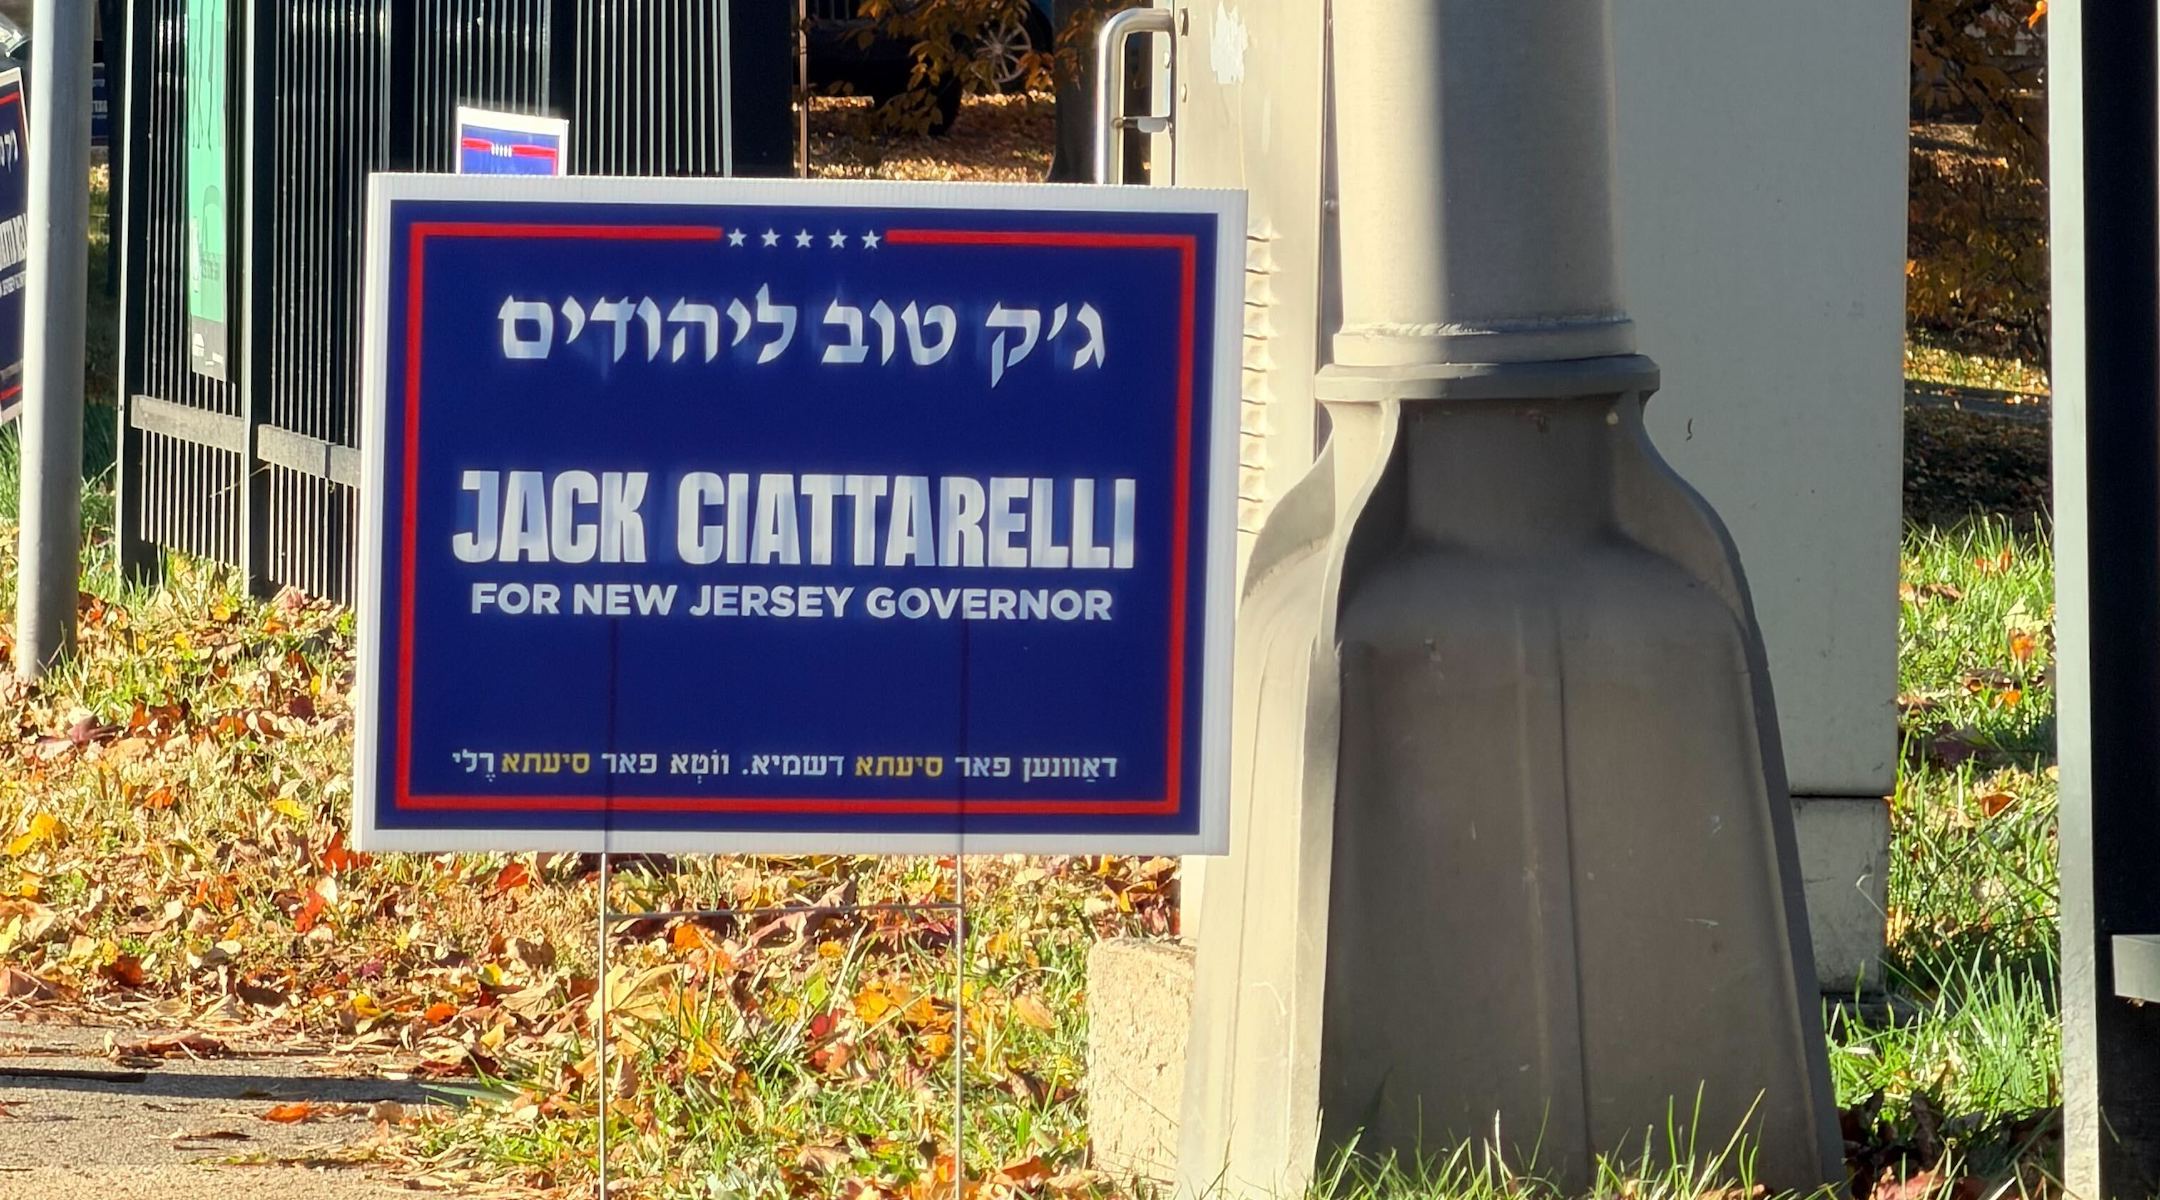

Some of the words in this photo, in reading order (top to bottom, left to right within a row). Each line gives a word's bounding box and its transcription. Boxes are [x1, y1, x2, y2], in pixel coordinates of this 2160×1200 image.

[497, 283, 797, 365] ליהודים
[821, 298, 957, 366] טוב
[453, 470, 648, 564] JACK
[677, 472, 1136, 569] CIATTARELLI
[472, 583, 561, 615] FOR
[574, 584, 677, 616] NEW
[690, 585, 855, 618] JERSEY
[866, 587, 1113, 621] GOVERNOR
[501, 752, 590, 774] סיעתא
[601, 752, 658, 774] פאר
[742, 754, 845, 776] דשמיא.
[855, 756, 943, 777] סיעתא
[954, 756, 1011, 778] פאר
